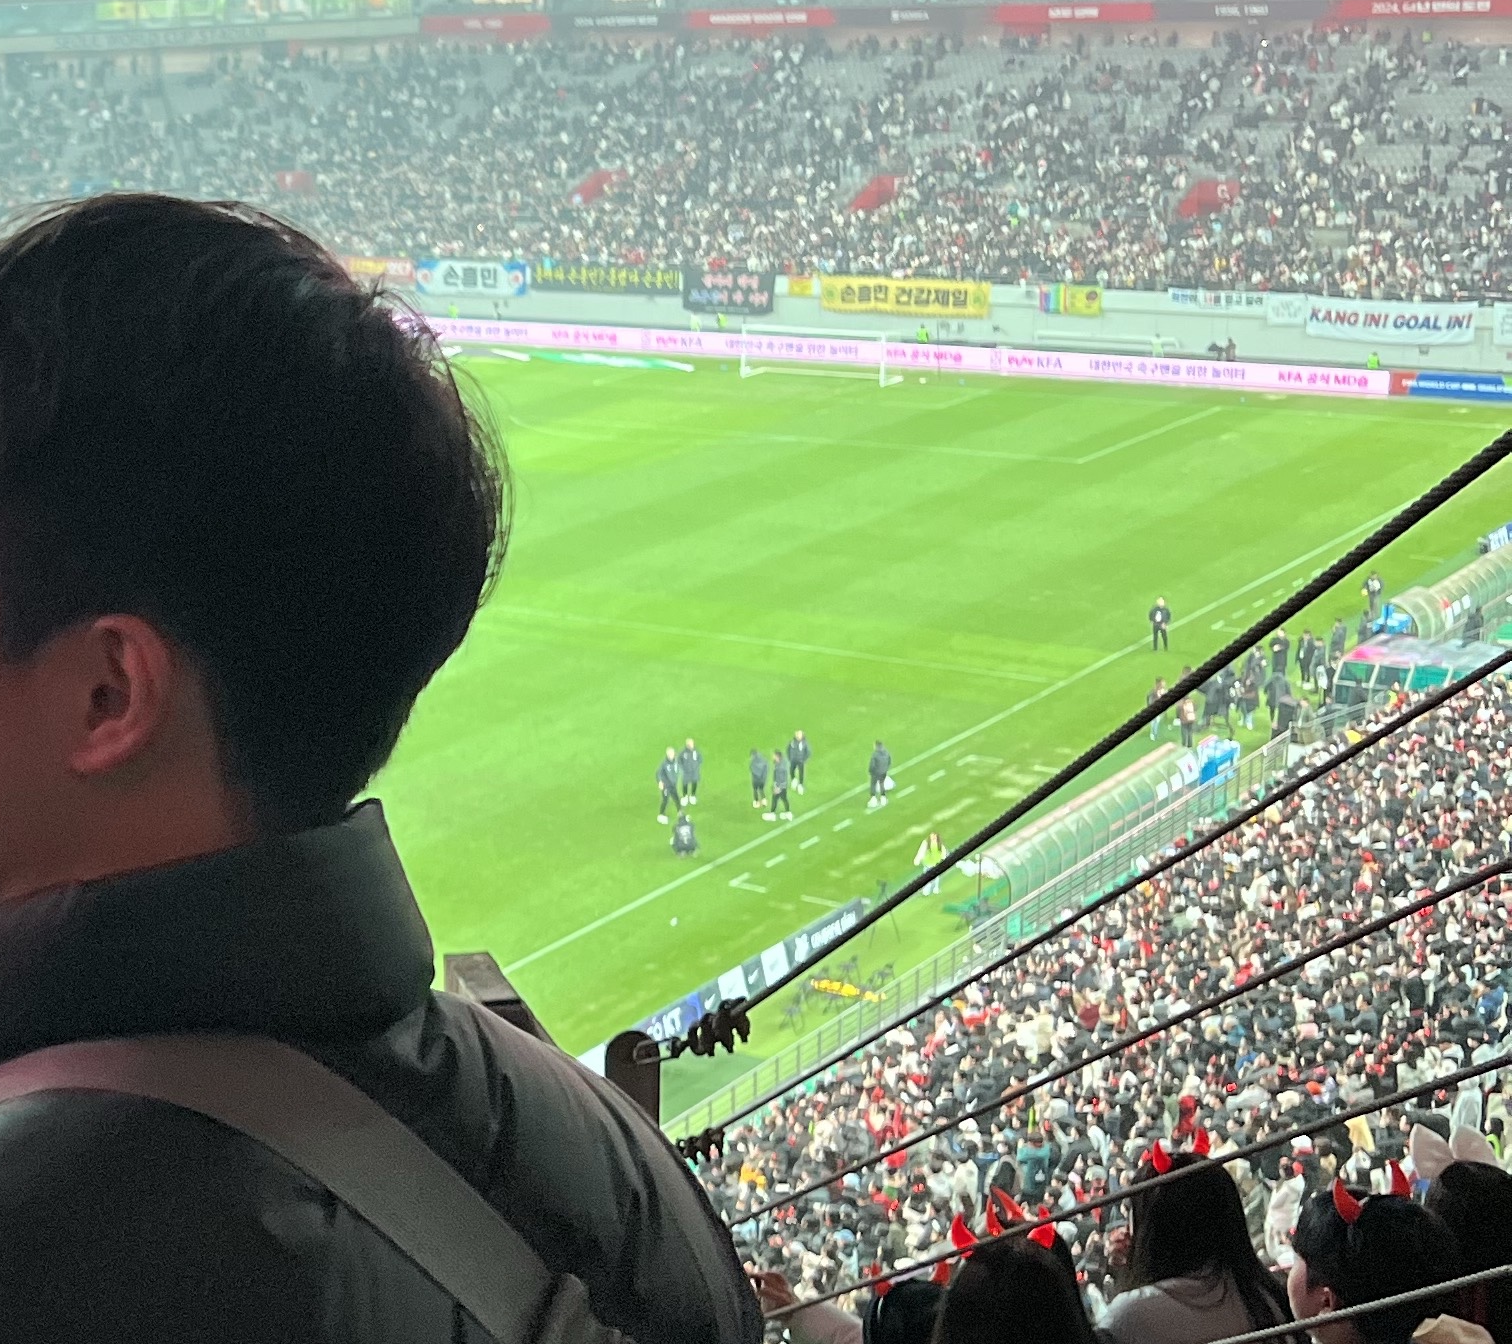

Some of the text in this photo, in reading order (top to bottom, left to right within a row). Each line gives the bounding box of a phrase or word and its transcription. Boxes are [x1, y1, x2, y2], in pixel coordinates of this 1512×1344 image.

[841, 285, 968, 309] 손흥민 건강제일
[1310, 306, 1360, 326] KANG
[1393, 315, 1442, 330] GOAL
